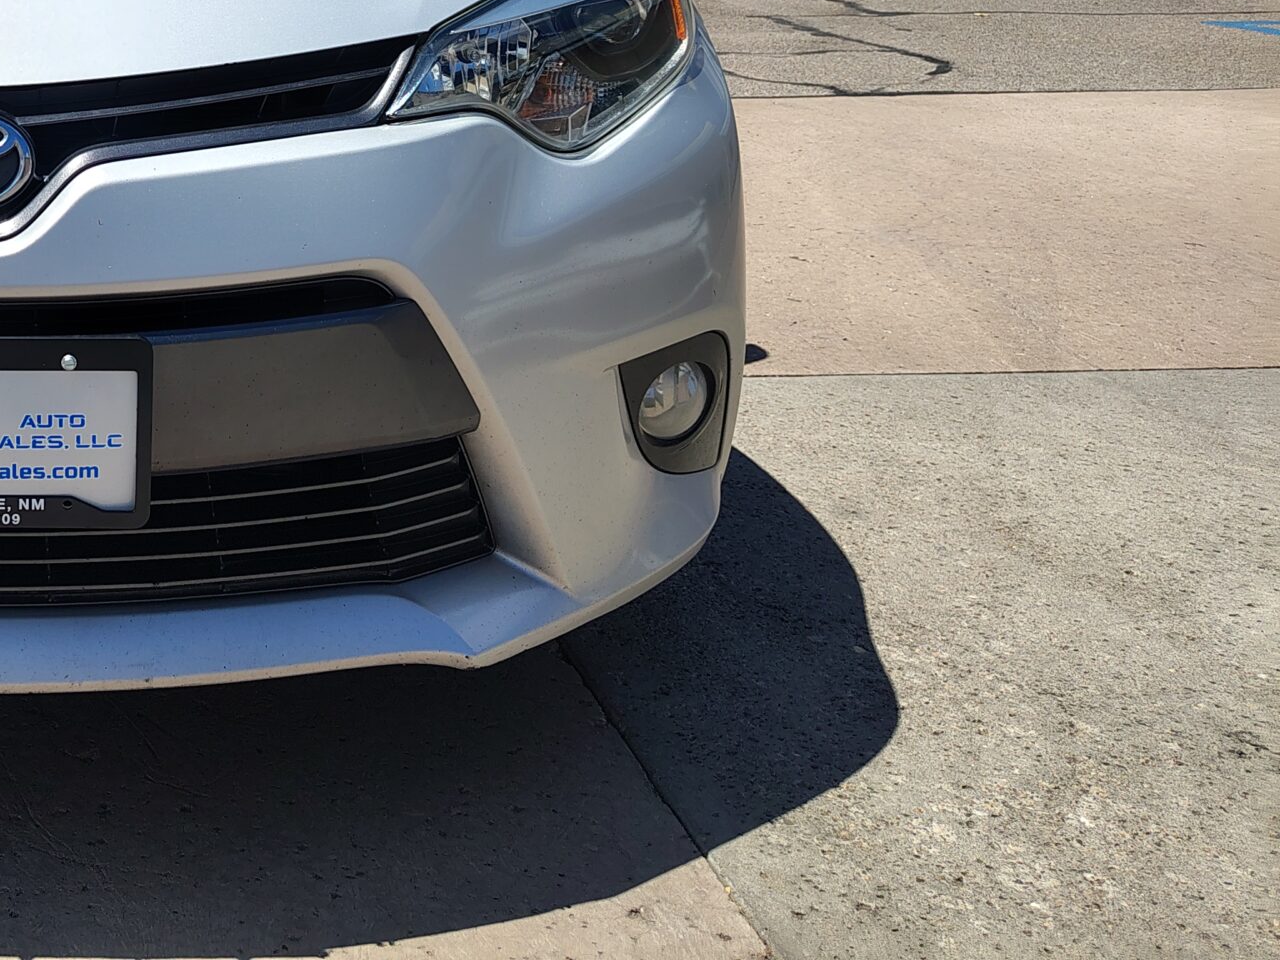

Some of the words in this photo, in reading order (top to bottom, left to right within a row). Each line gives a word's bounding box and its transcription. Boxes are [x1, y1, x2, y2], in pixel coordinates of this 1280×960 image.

[19, 413, 87, 429] AUTO
[75, 433, 123, 449] LLC
[18, 498, 46, 511] NM
